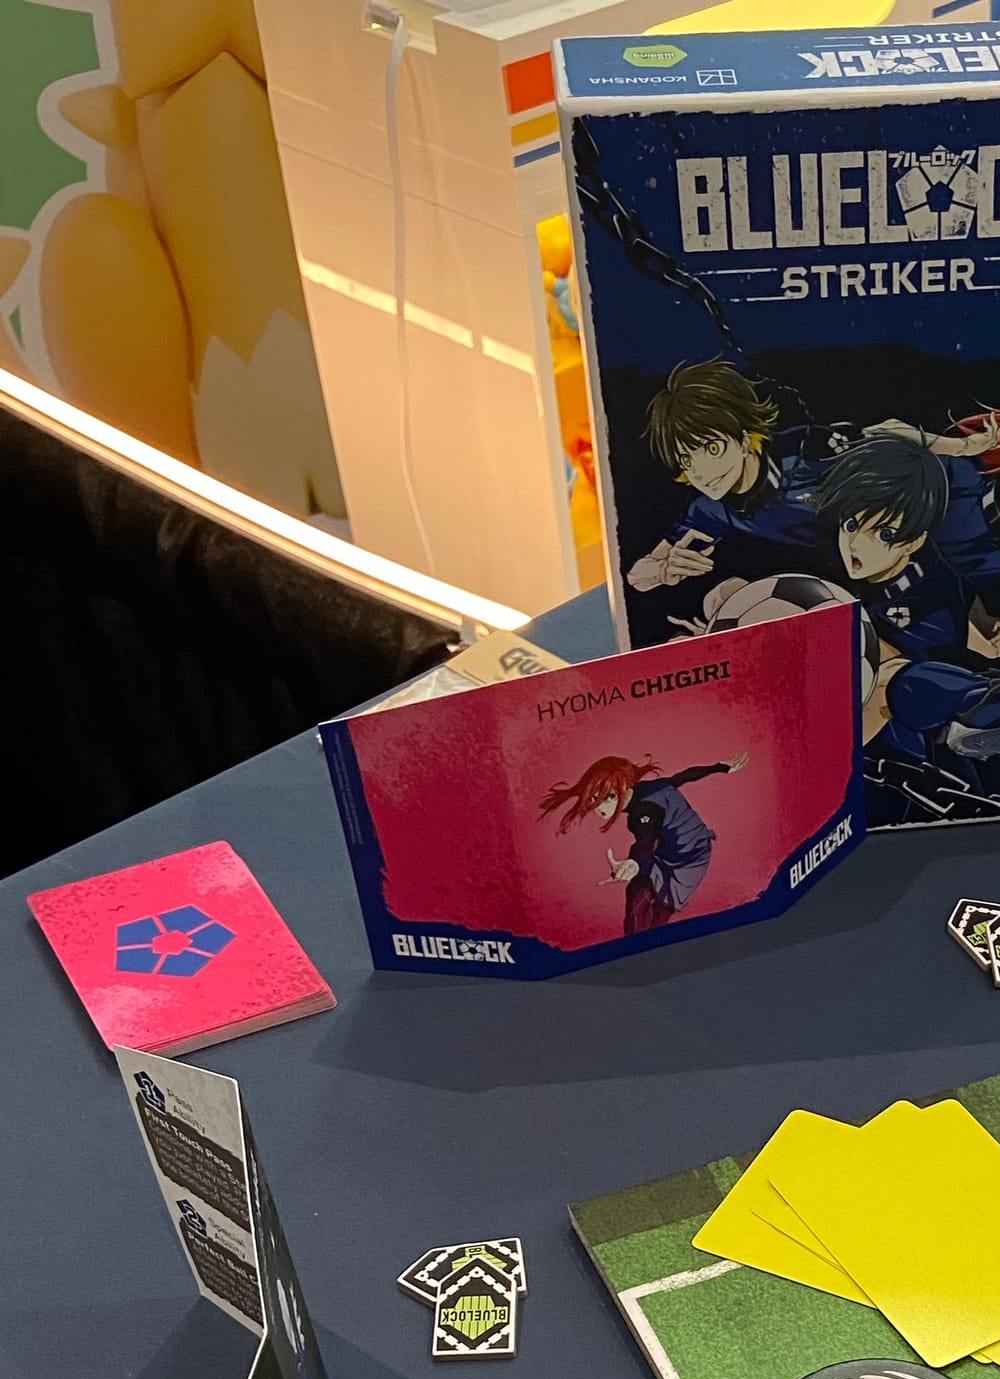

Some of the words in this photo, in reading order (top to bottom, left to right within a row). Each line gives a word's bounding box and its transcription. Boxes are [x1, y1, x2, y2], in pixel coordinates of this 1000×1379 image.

[589, 75, 687, 85] KODANSHA
[889, 146, 977, 169] ブルーロック
[781, 258, 977, 300] STRIKER
[537, 686, 625, 722] HYOMA
[630, 660, 731, 699] CHIGIRI
[789, 814, 853, 890] BLUELOCK
[391, 933, 516, 964] BLUELOCK
[144, 1107, 171, 1133] First
[172, 1126, 204, 1153] Touch
[205, 1147, 233, 1172] Pass
[441, 1309, 507, 1323] BLUELOCK
